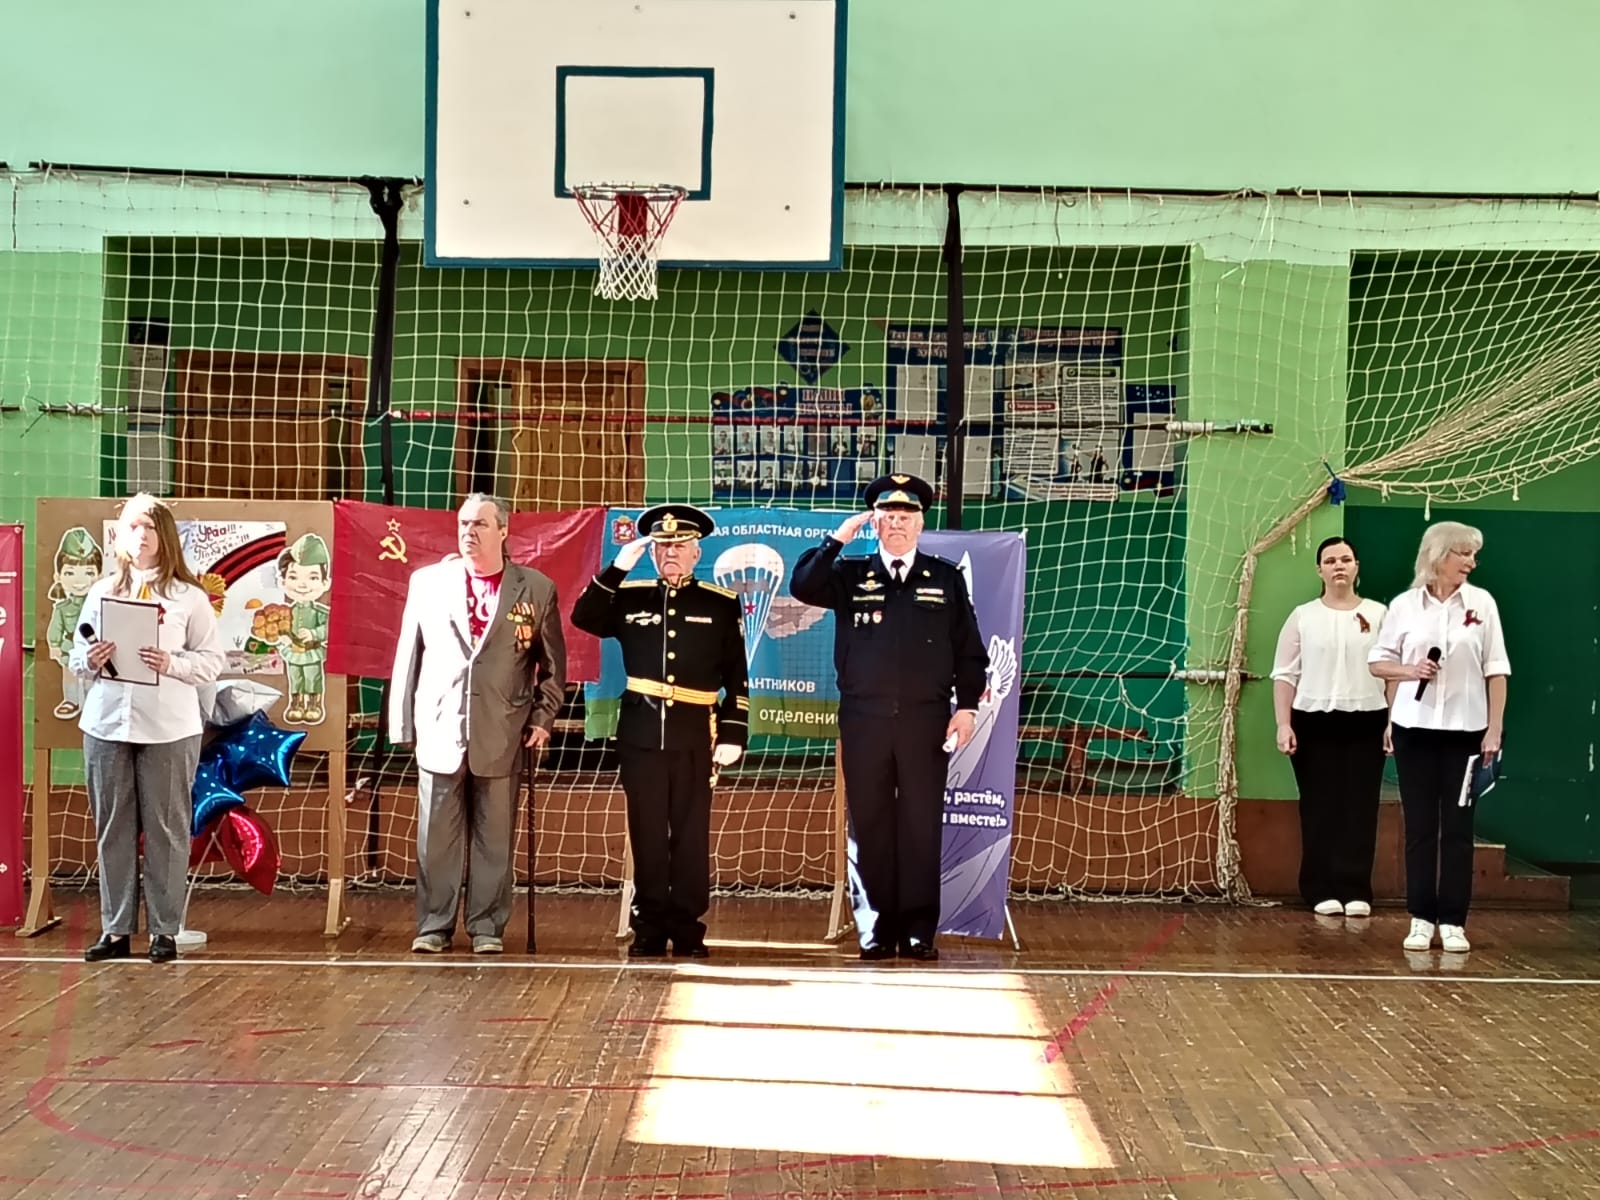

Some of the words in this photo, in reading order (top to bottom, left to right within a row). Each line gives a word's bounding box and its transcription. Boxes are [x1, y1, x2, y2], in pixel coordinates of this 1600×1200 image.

[710, 525, 730, 537] АЯ
[732, 525, 801, 537] ОБЛАСТНАЯ
[748, 677, 815, 693] АНТНИКОВ
[760, 708, 838, 725] отделени
[954, 790, 1005, 808] растём,
